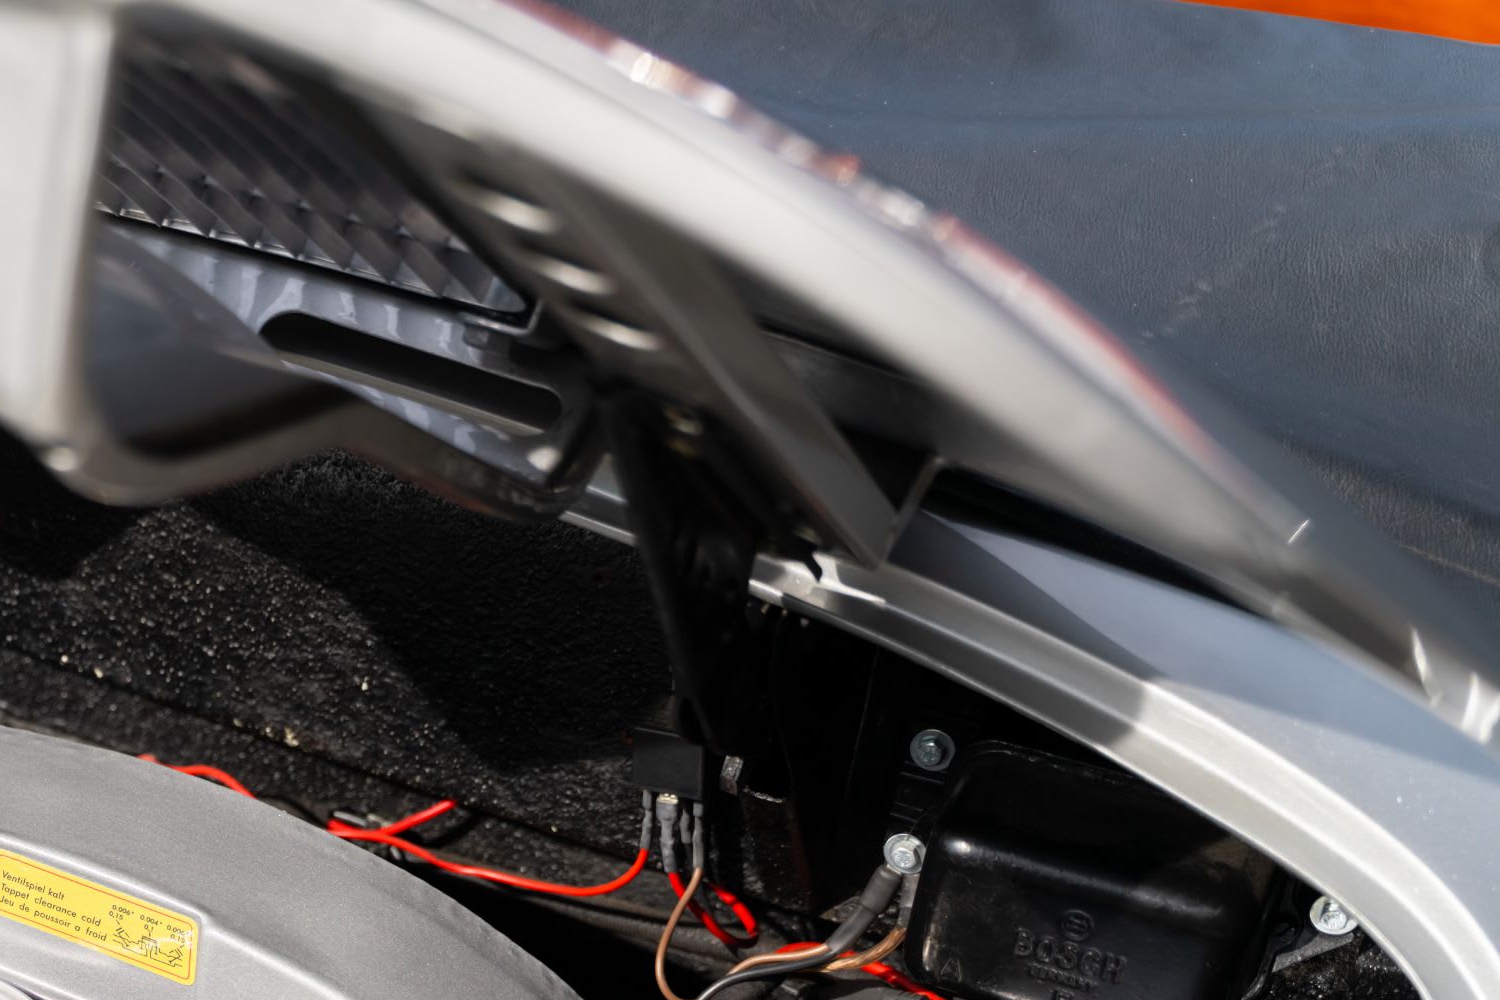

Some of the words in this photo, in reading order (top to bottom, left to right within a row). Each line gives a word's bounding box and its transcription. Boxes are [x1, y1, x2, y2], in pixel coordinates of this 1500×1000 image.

[0, 882, 29, 902] Tappet
[34, 894, 77, 918] clearance
[80, 911, 101, 928] cold
[1, 869, 45, 895] Ventilspiel
[47, 886, 65, 901] kalt
[0, 894, 14, 907] Jeu
[18, 901, 30, 913] de
[33, 909, 71, 930] poussoir
[84, 925, 107, 942] froid
[1014, 927, 1128, 985] BOSCH
